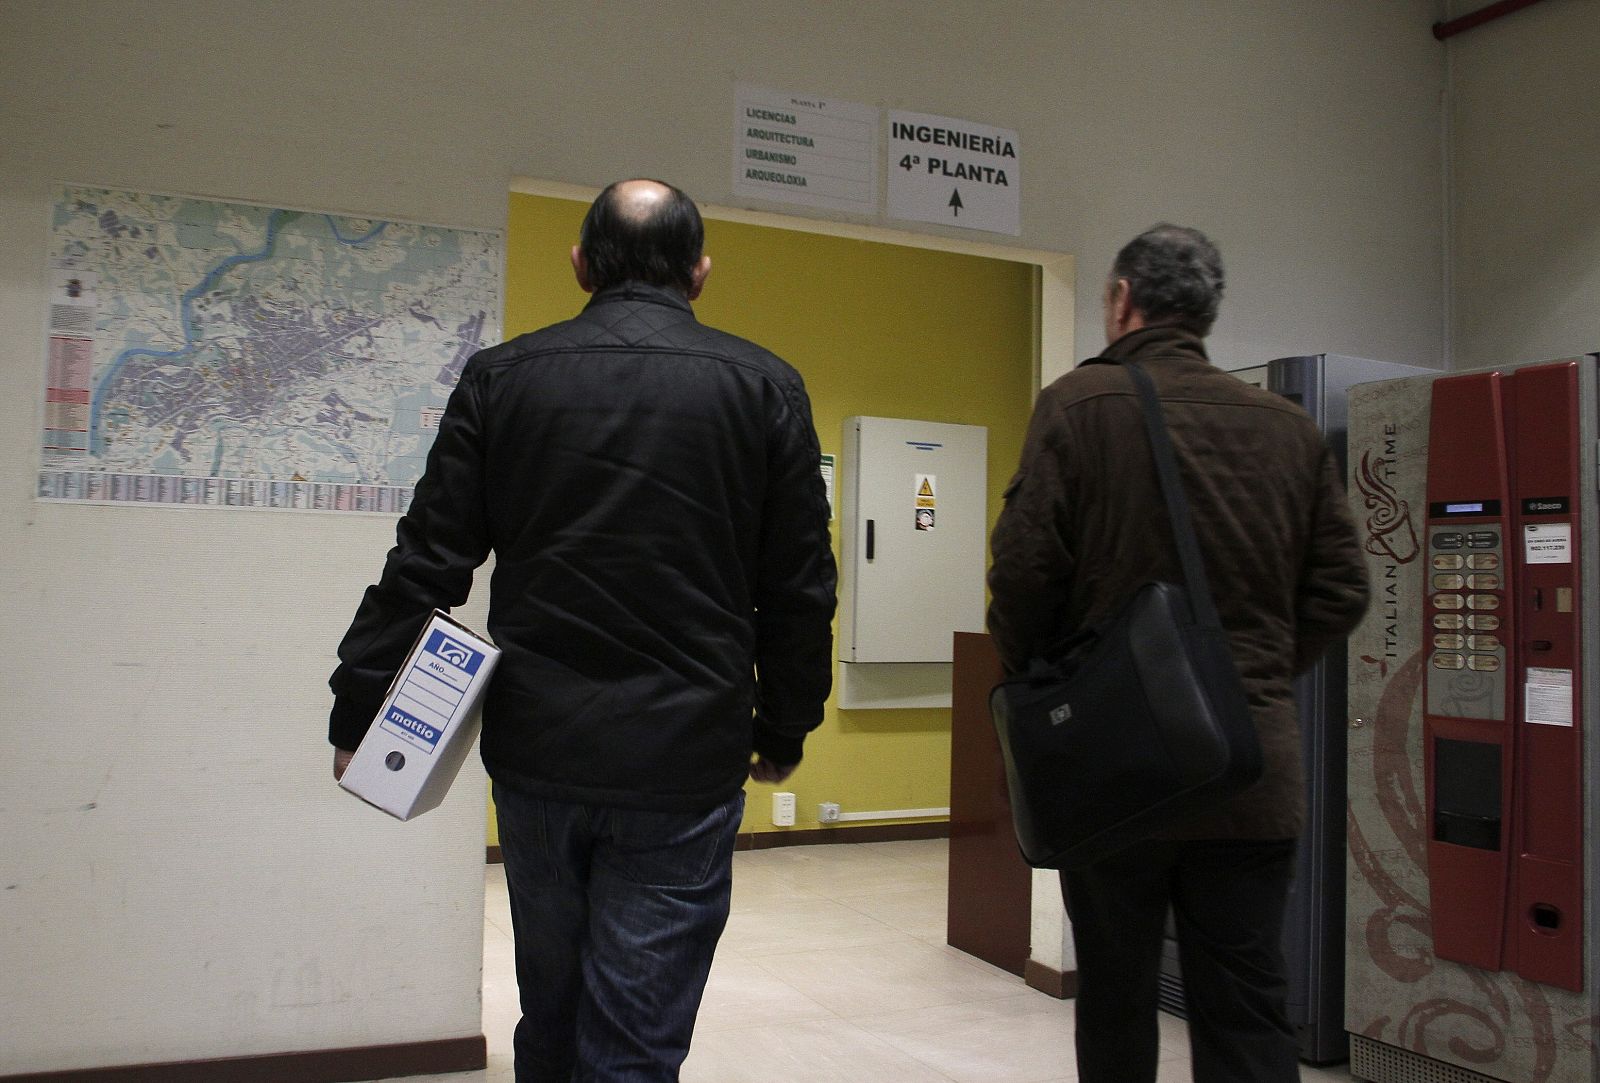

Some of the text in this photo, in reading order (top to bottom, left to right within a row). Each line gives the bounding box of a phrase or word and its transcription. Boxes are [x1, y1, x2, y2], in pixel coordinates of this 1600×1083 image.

[746, 107, 797, 126] LICENCIAS
[746, 127, 815, 149] ARQUITECTURA
[892, 121, 1016, 159] INGENIERÍA
[745, 148, 797, 167] URBANISMO
[745, 168, 808, 188] ARQUEOLOXIA
[899, 153, 1009, 187] 4ª PLANTA
[1385, 423, 1397, 658] ITALIAN TIME
[429, 662, 445, 673] AÑO
[391, 711, 434, 739] mattio
